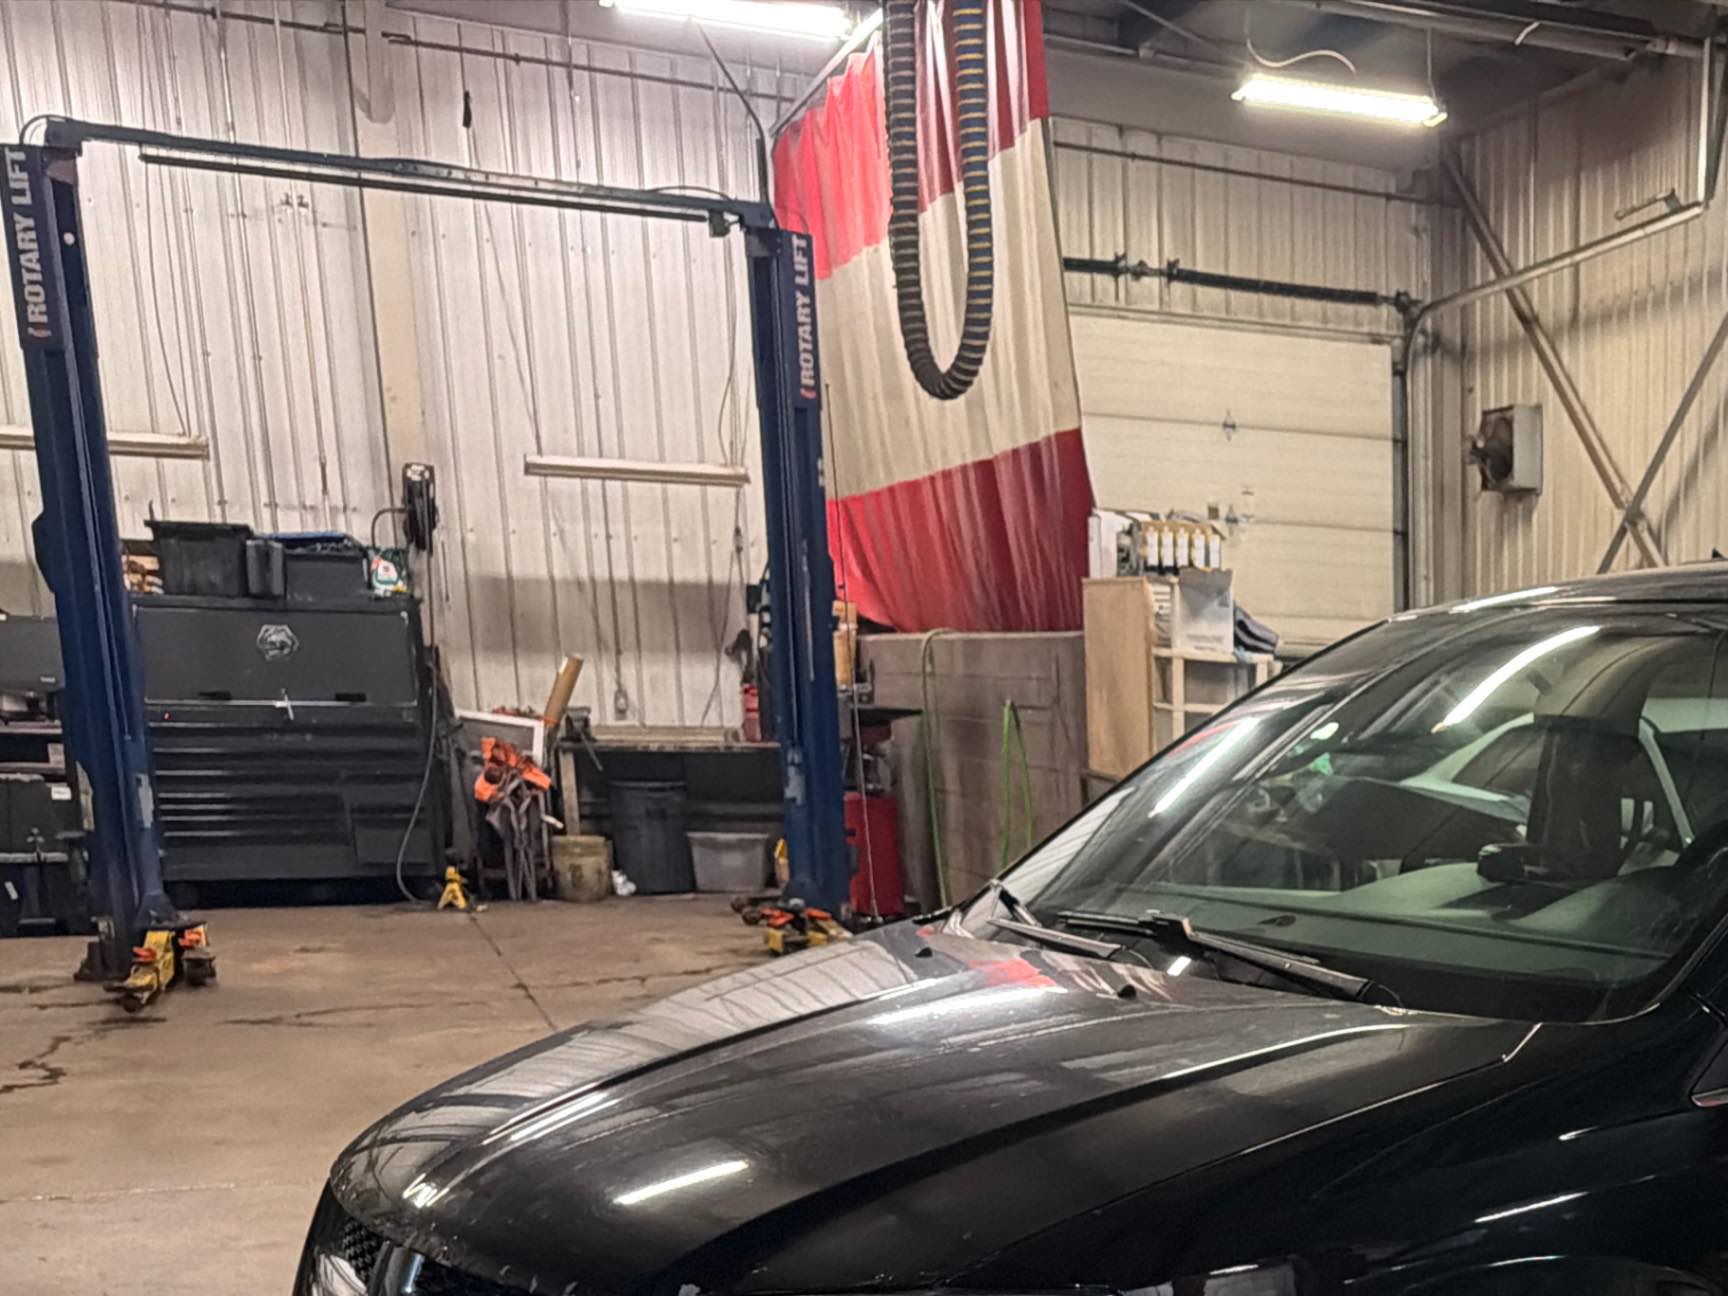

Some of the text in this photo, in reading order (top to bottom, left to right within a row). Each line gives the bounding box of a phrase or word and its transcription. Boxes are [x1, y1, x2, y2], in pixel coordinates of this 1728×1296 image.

[5, 146, 48, 323] ROTARY LIFT
[792, 234, 815, 387] ROTARY LIFT
